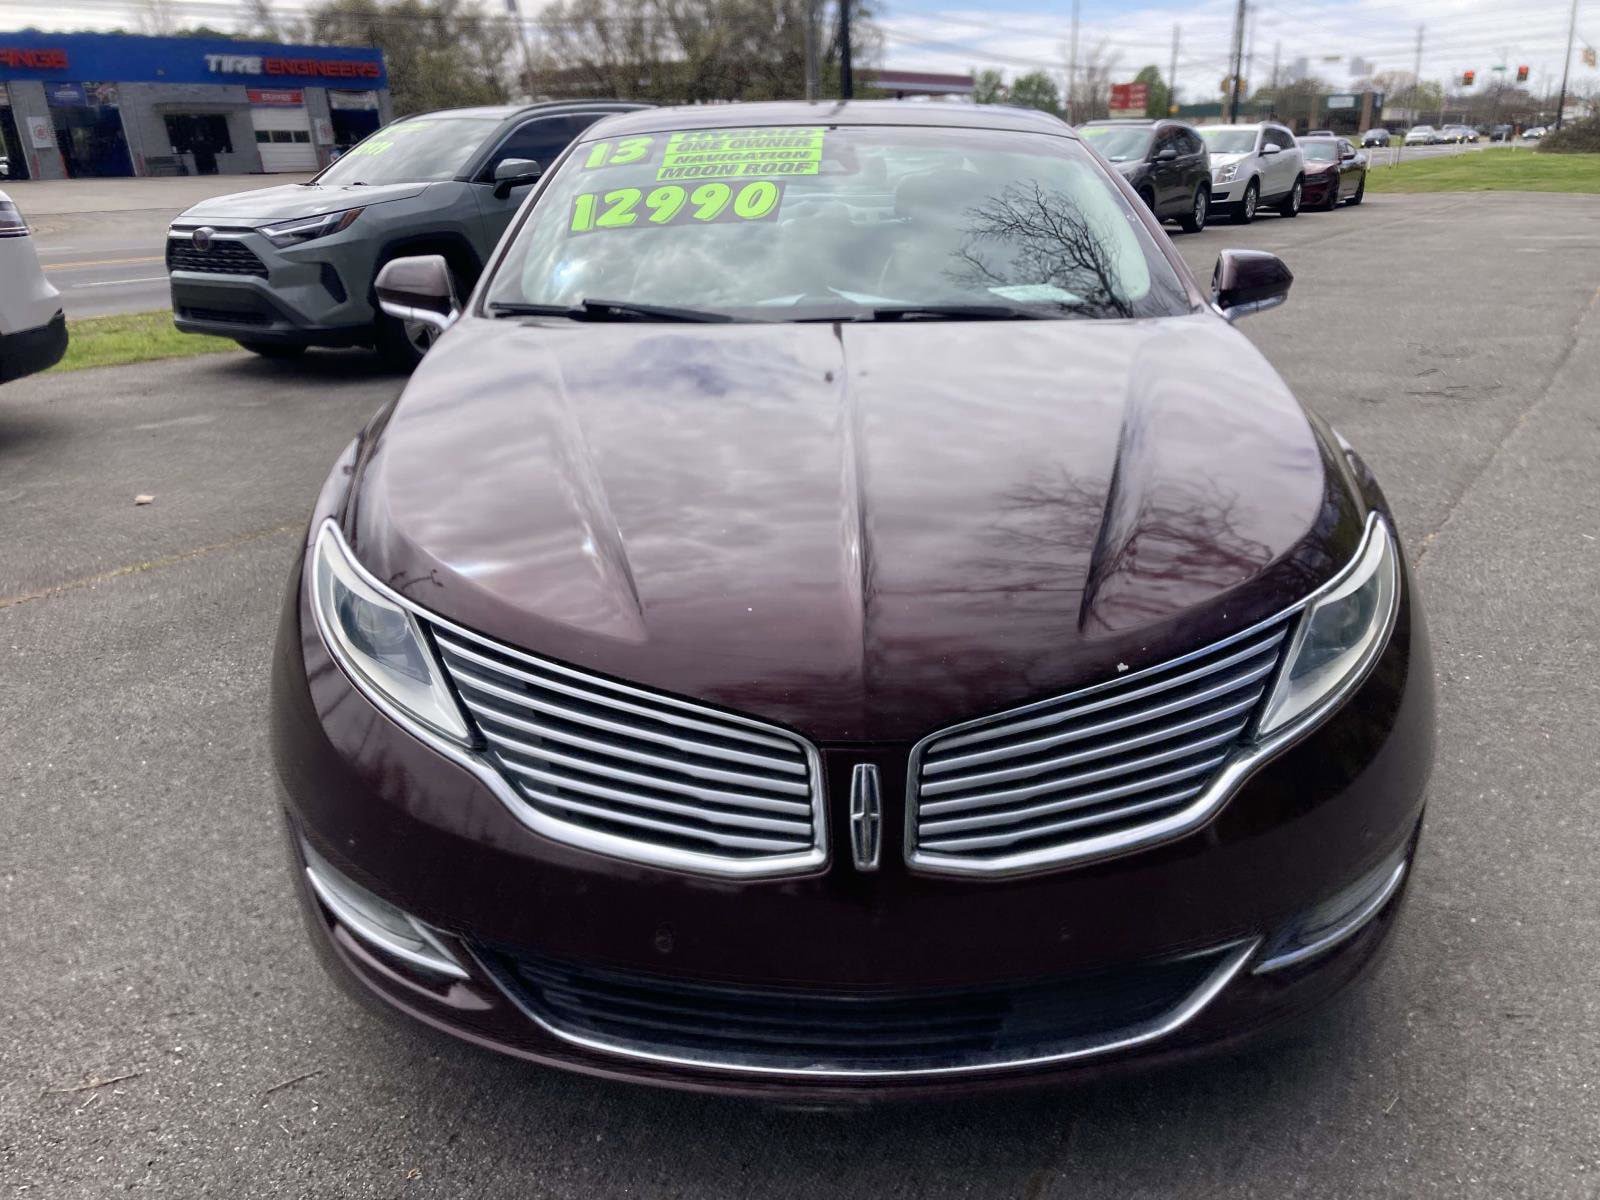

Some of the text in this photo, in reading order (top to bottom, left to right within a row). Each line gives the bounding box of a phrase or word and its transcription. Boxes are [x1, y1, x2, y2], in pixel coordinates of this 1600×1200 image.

[205, 54, 380, 78] TIRE ENGINEERS
[584, 136, 653, 169] 13
[675, 136, 813, 153] ONE OWNER
[673, 150, 811, 165] NAVIGATION
[660, 162, 814, 179] MOON ROOF
[570, 180, 780, 233] 12990
